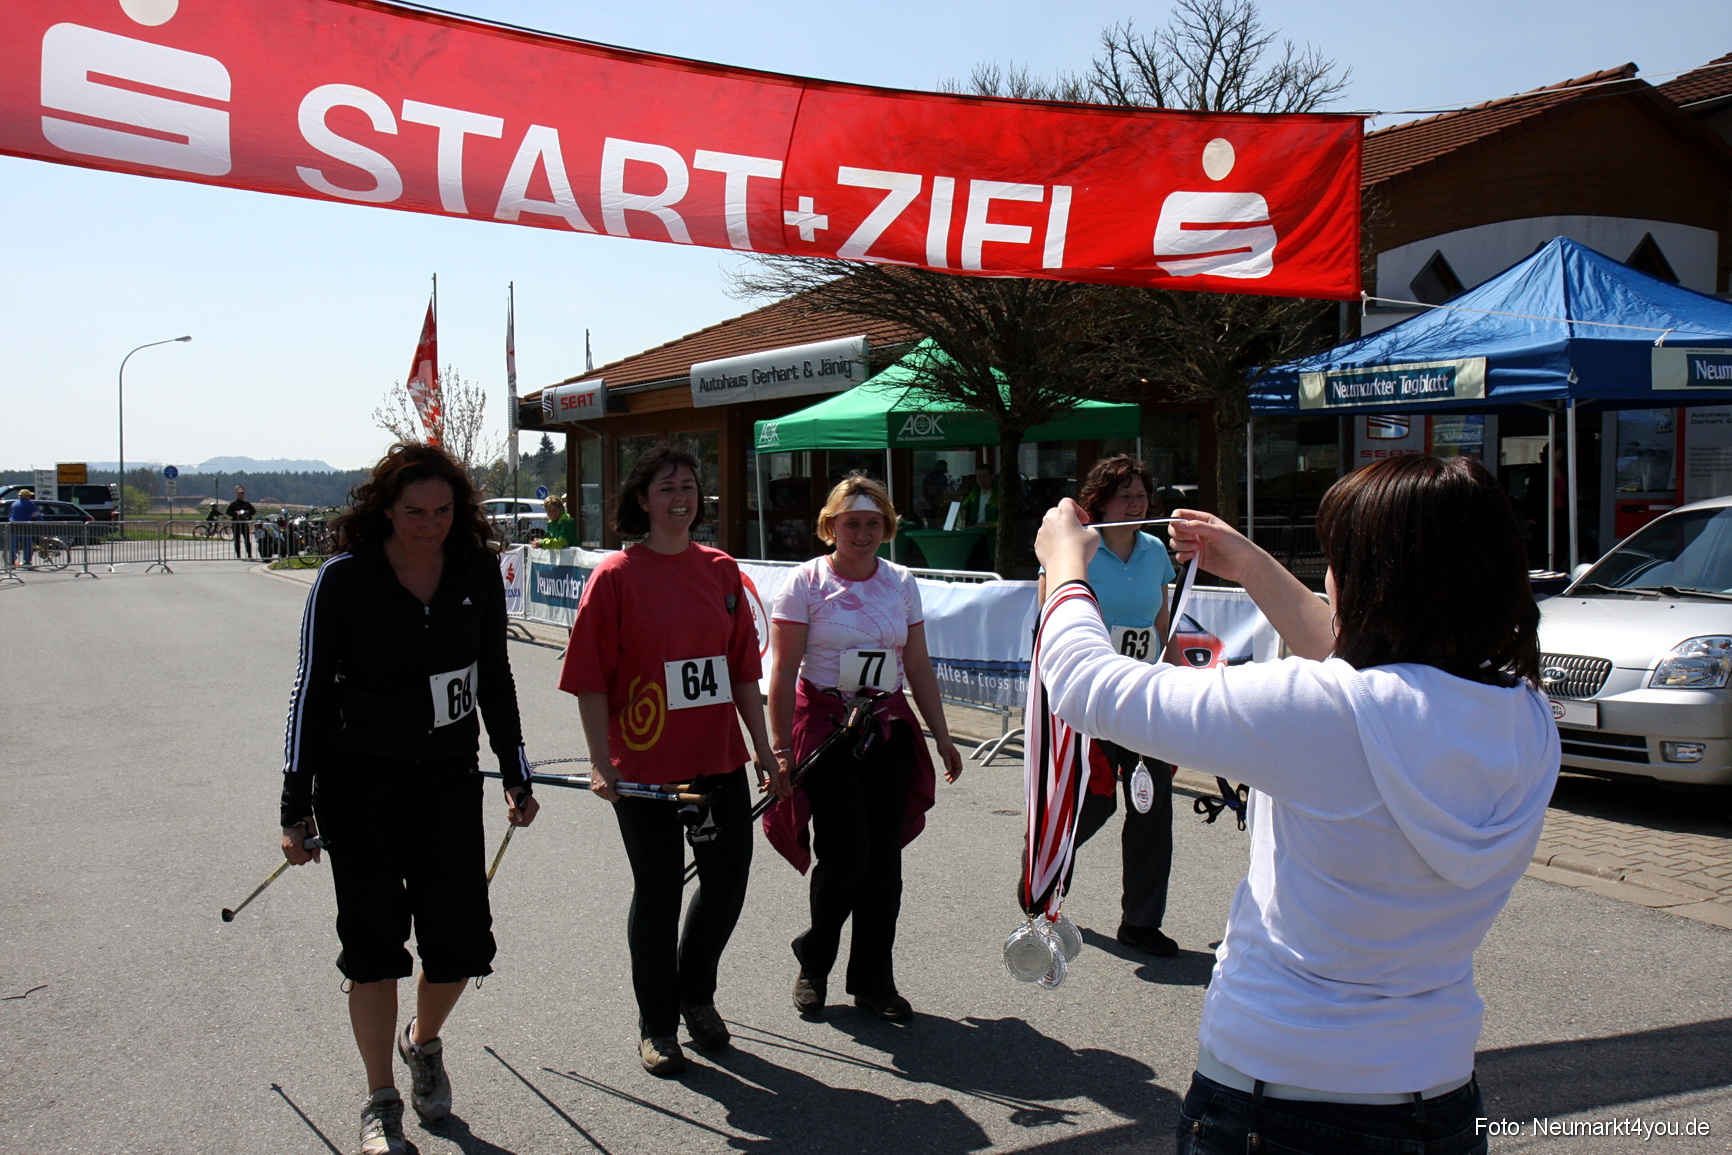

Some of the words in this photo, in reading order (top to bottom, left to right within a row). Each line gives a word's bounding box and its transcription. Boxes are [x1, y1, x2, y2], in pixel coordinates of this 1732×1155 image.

[699, 373, 748, 393] Autohaus
[752, 365, 800, 385] Gerhart
[803, 360, 814, 378] &
[817, 355, 852, 378] Jänig
[1332, 378, 1397, 399] Neumarkter
[1399, 374, 1449, 395] Tagblatt
[560, 392, 595, 410] SEAT
[898, 414, 945, 435] AOK
[1120, 629, 1150, 660] 63
[681, 659, 718, 701] 64
[858, 651, 886, 687] 77
[937, 663, 975, 685] Altea.
[978, 672, 1009, 690] Cross
